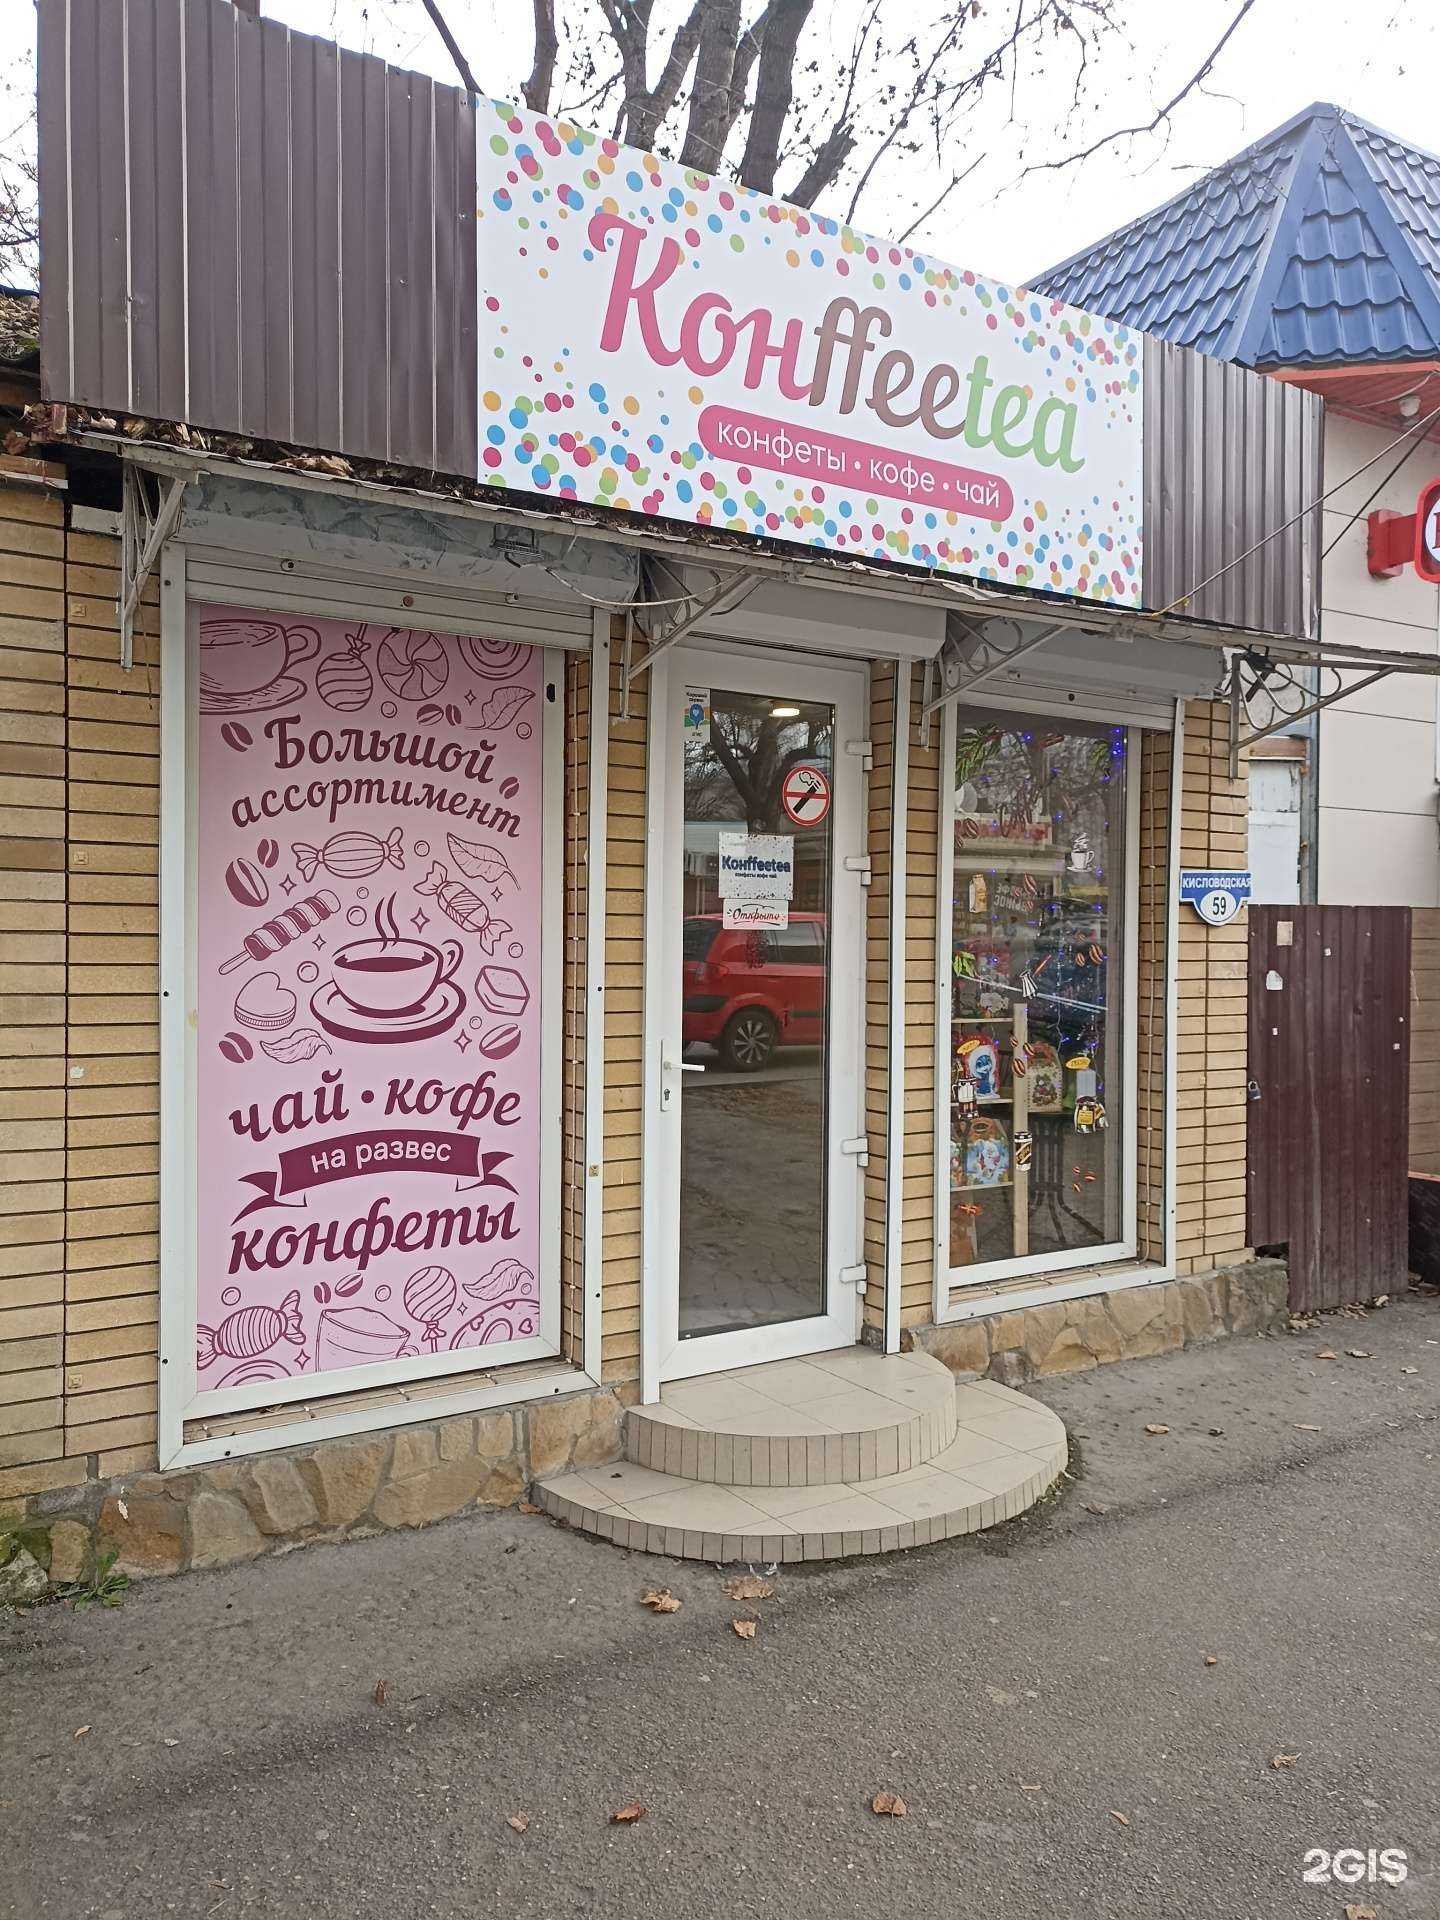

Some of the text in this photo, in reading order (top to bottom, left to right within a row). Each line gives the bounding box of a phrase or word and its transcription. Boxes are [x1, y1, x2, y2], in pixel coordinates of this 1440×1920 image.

[717, 421, 1000, 509] конфеты кофе чай
[264, 714, 497, 784] Большой
[231, 777, 521, 838] ассортимент
[1182, 877, 1251, 889] КИСЛОВОДСКАЯ
[1212, 896, 1227, 916] 59
[228, 1068, 522, 1142] чай кофе
[311, 1139, 451, 1173] на развес
[228, 1196, 520, 1275] конфеты
